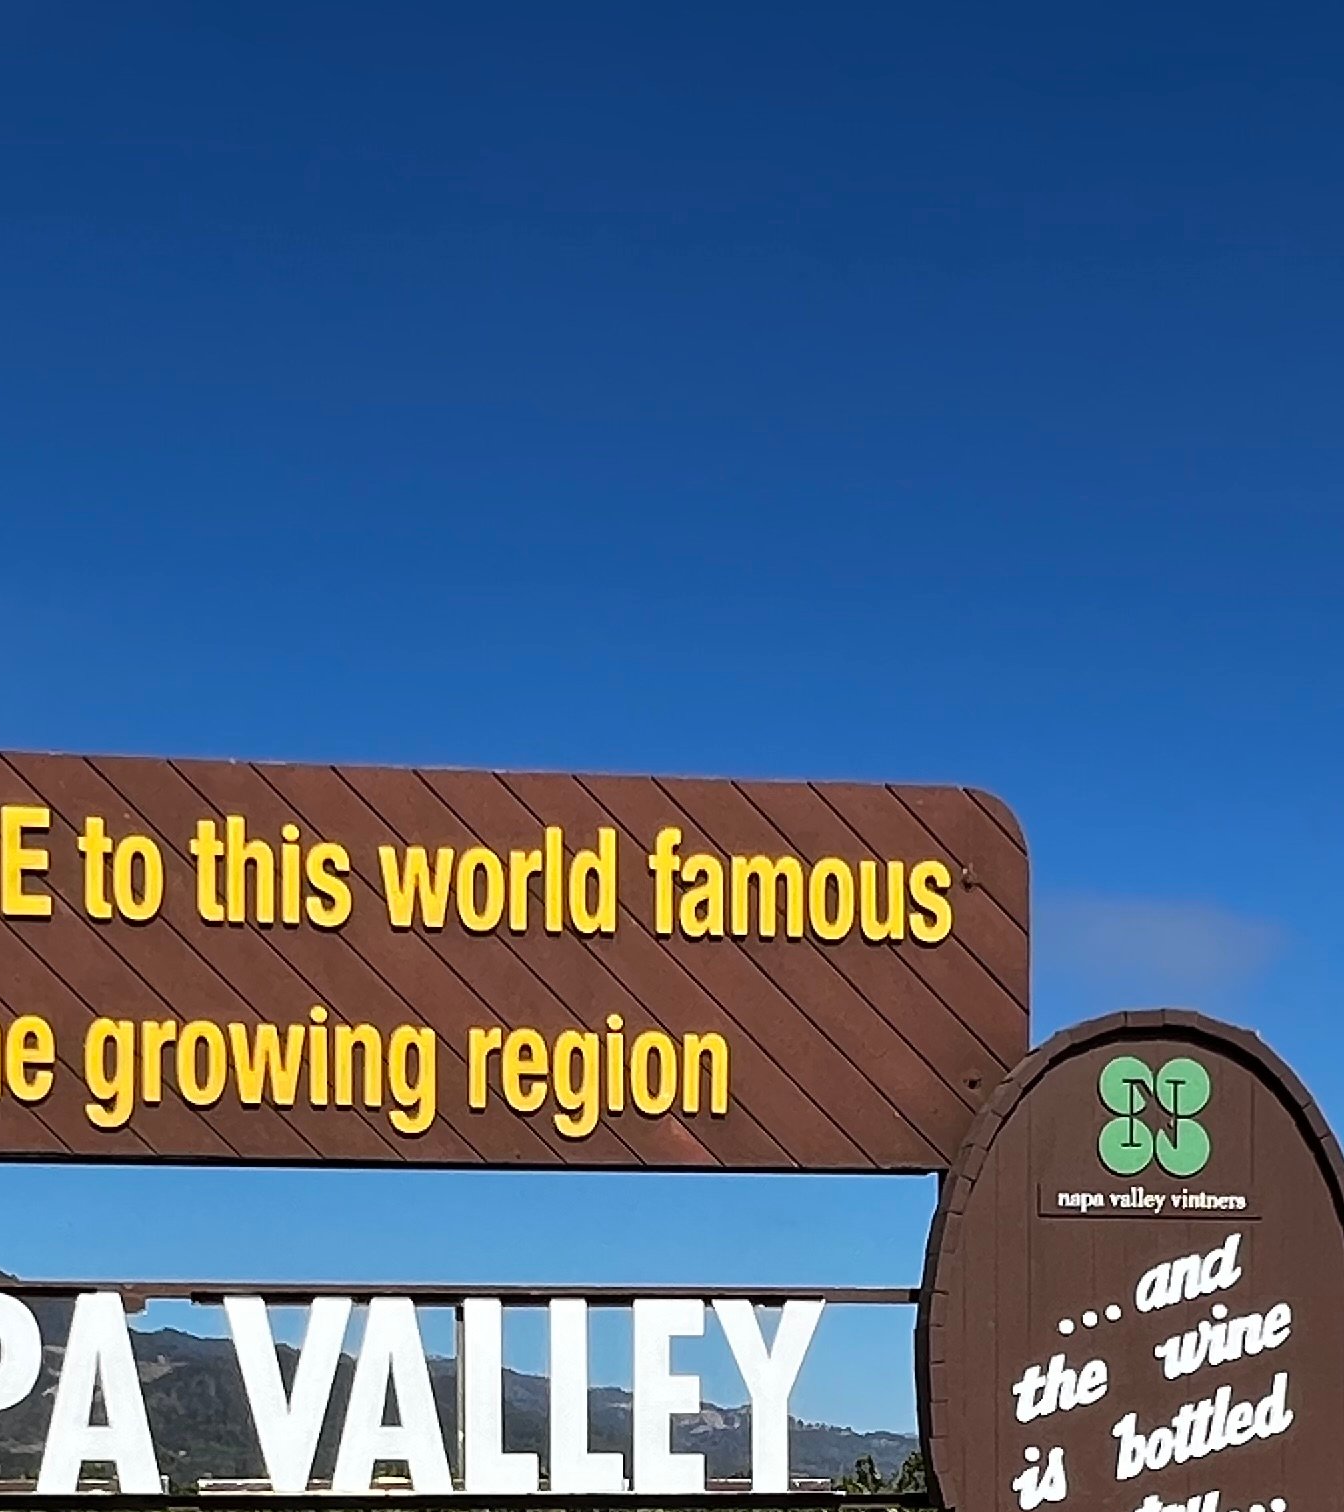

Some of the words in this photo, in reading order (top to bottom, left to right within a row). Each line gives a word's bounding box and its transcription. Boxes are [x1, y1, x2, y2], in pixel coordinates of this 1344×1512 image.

[79, 816, 164, 919] to
[191, 814, 352, 926] this
[378, 825, 616, 934] world
[649, 826, 953, 943] famous
[83, 1005, 436, 1134] growing
[467, 1013, 729, 1137] region
[1058, 1192, 1104, 1213] napa
[1109, 1186, 1166, 1214] valley
[1171, 1188, 1247, 1210] vintners
[222, 1295, 827, 1495] VALLEY
[1012, 1352, 1108, 1424] the
[1154, 1302, 1293, 1381] wine
[1012, 1445, 1068, 1511] is
[1112, 1371, 1295, 1481] bottled
